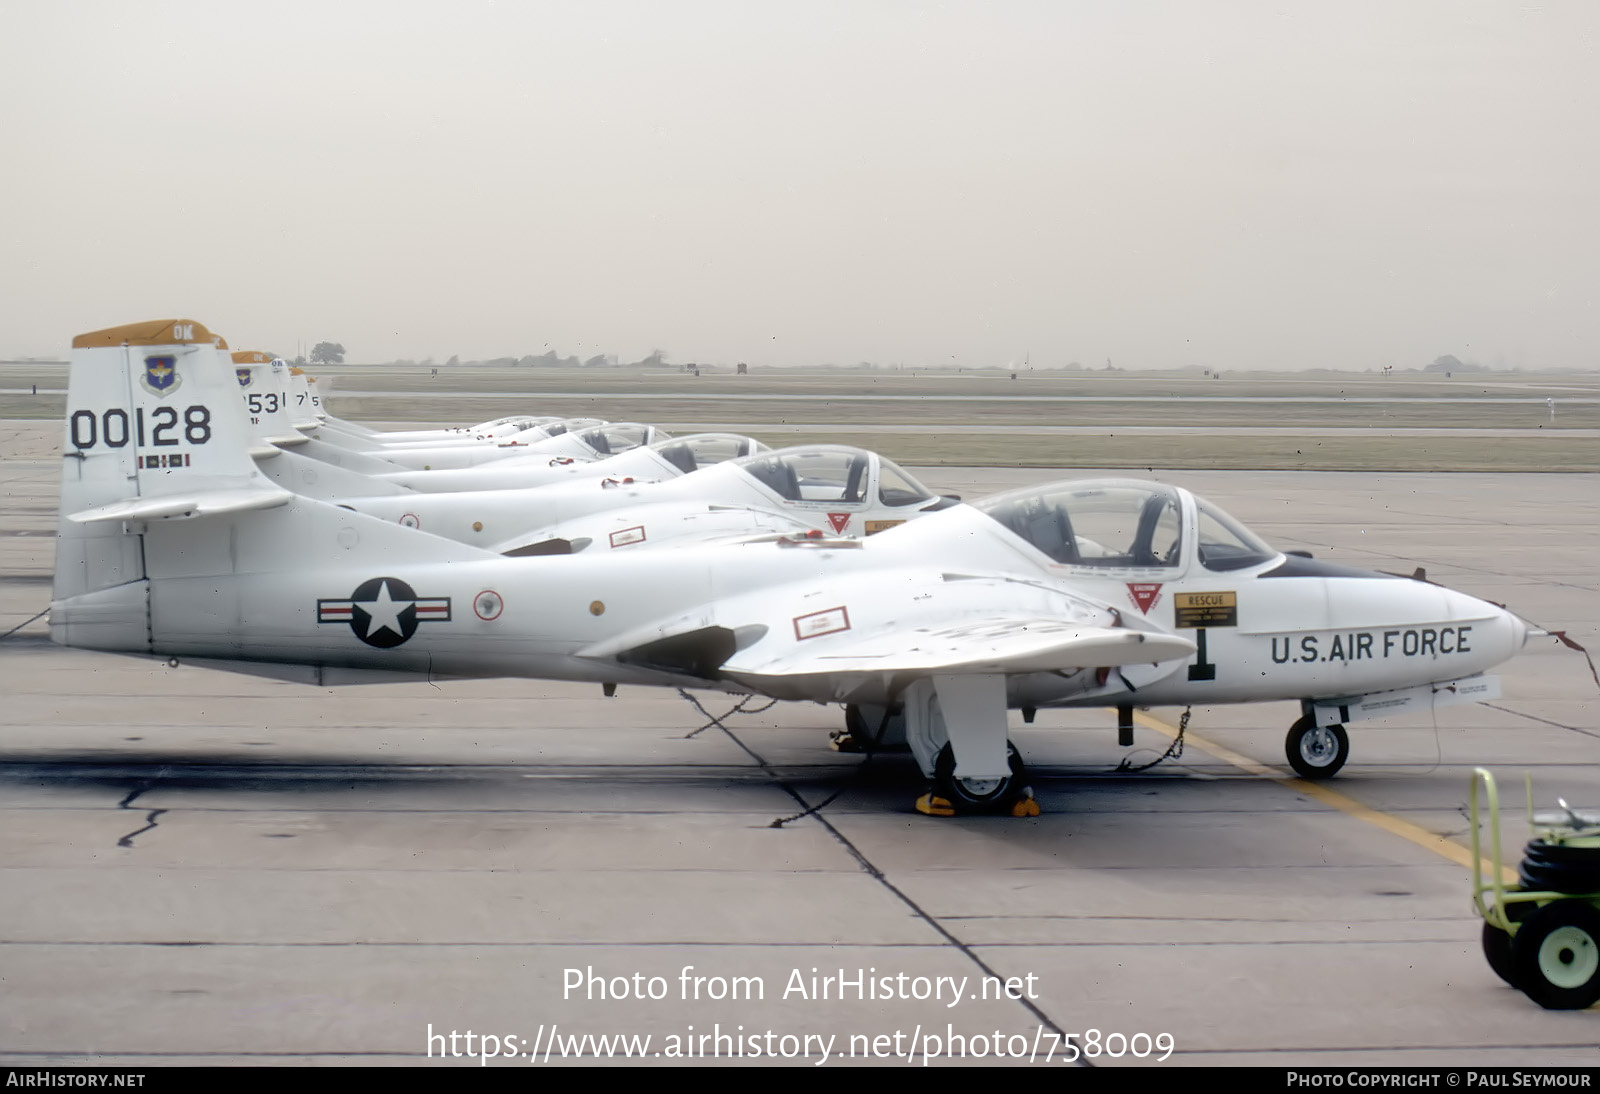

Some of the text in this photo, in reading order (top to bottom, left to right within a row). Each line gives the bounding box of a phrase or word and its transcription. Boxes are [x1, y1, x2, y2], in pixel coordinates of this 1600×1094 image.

[173, 324, 193, 340] OK
[242, 393, 279, 414] 53
[70, 405, 211, 449] 00128
[1188, 594, 1225, 606] RESCUE
[1383, 626, 1473, 658] FORCE
